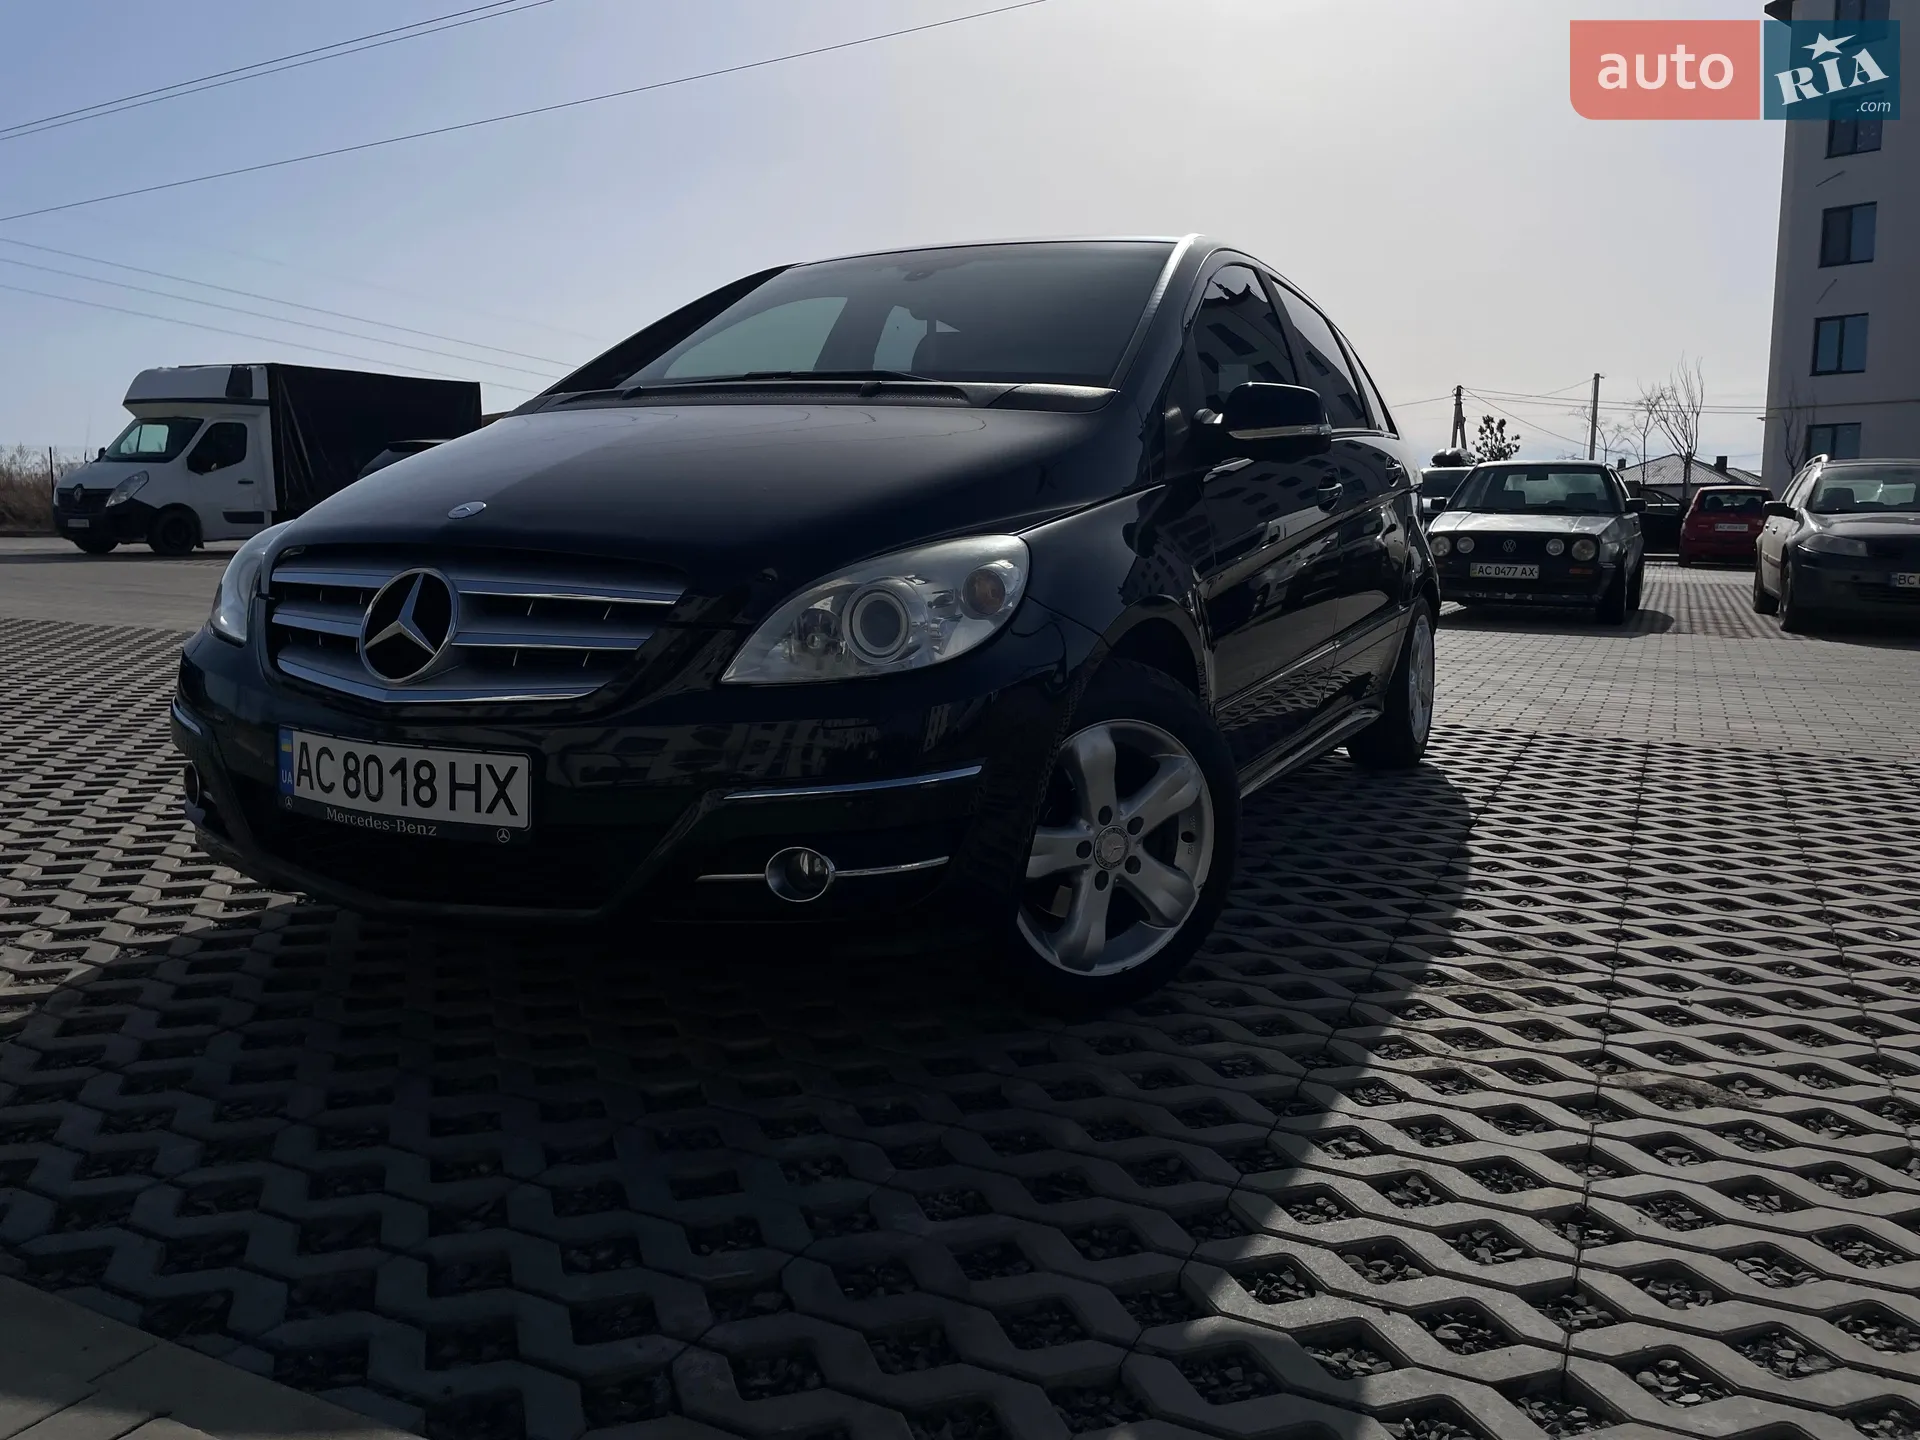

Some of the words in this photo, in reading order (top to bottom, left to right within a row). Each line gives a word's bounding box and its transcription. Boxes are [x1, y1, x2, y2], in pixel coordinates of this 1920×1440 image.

[1477, 565, 1492, 576] AC
[1494, 566, 1518, 577] 0477
[1520, 567, 1536, 577] AX
[1898, 574, 1915, 586] BC
[281, 769, 293, 785] UA
[296, 741, 336, 795] AC
[342, 751, 438, 809] 8018
[449, 761, 519, 817] HX
[325, 806, 437, 837] Mercedes-Benz
